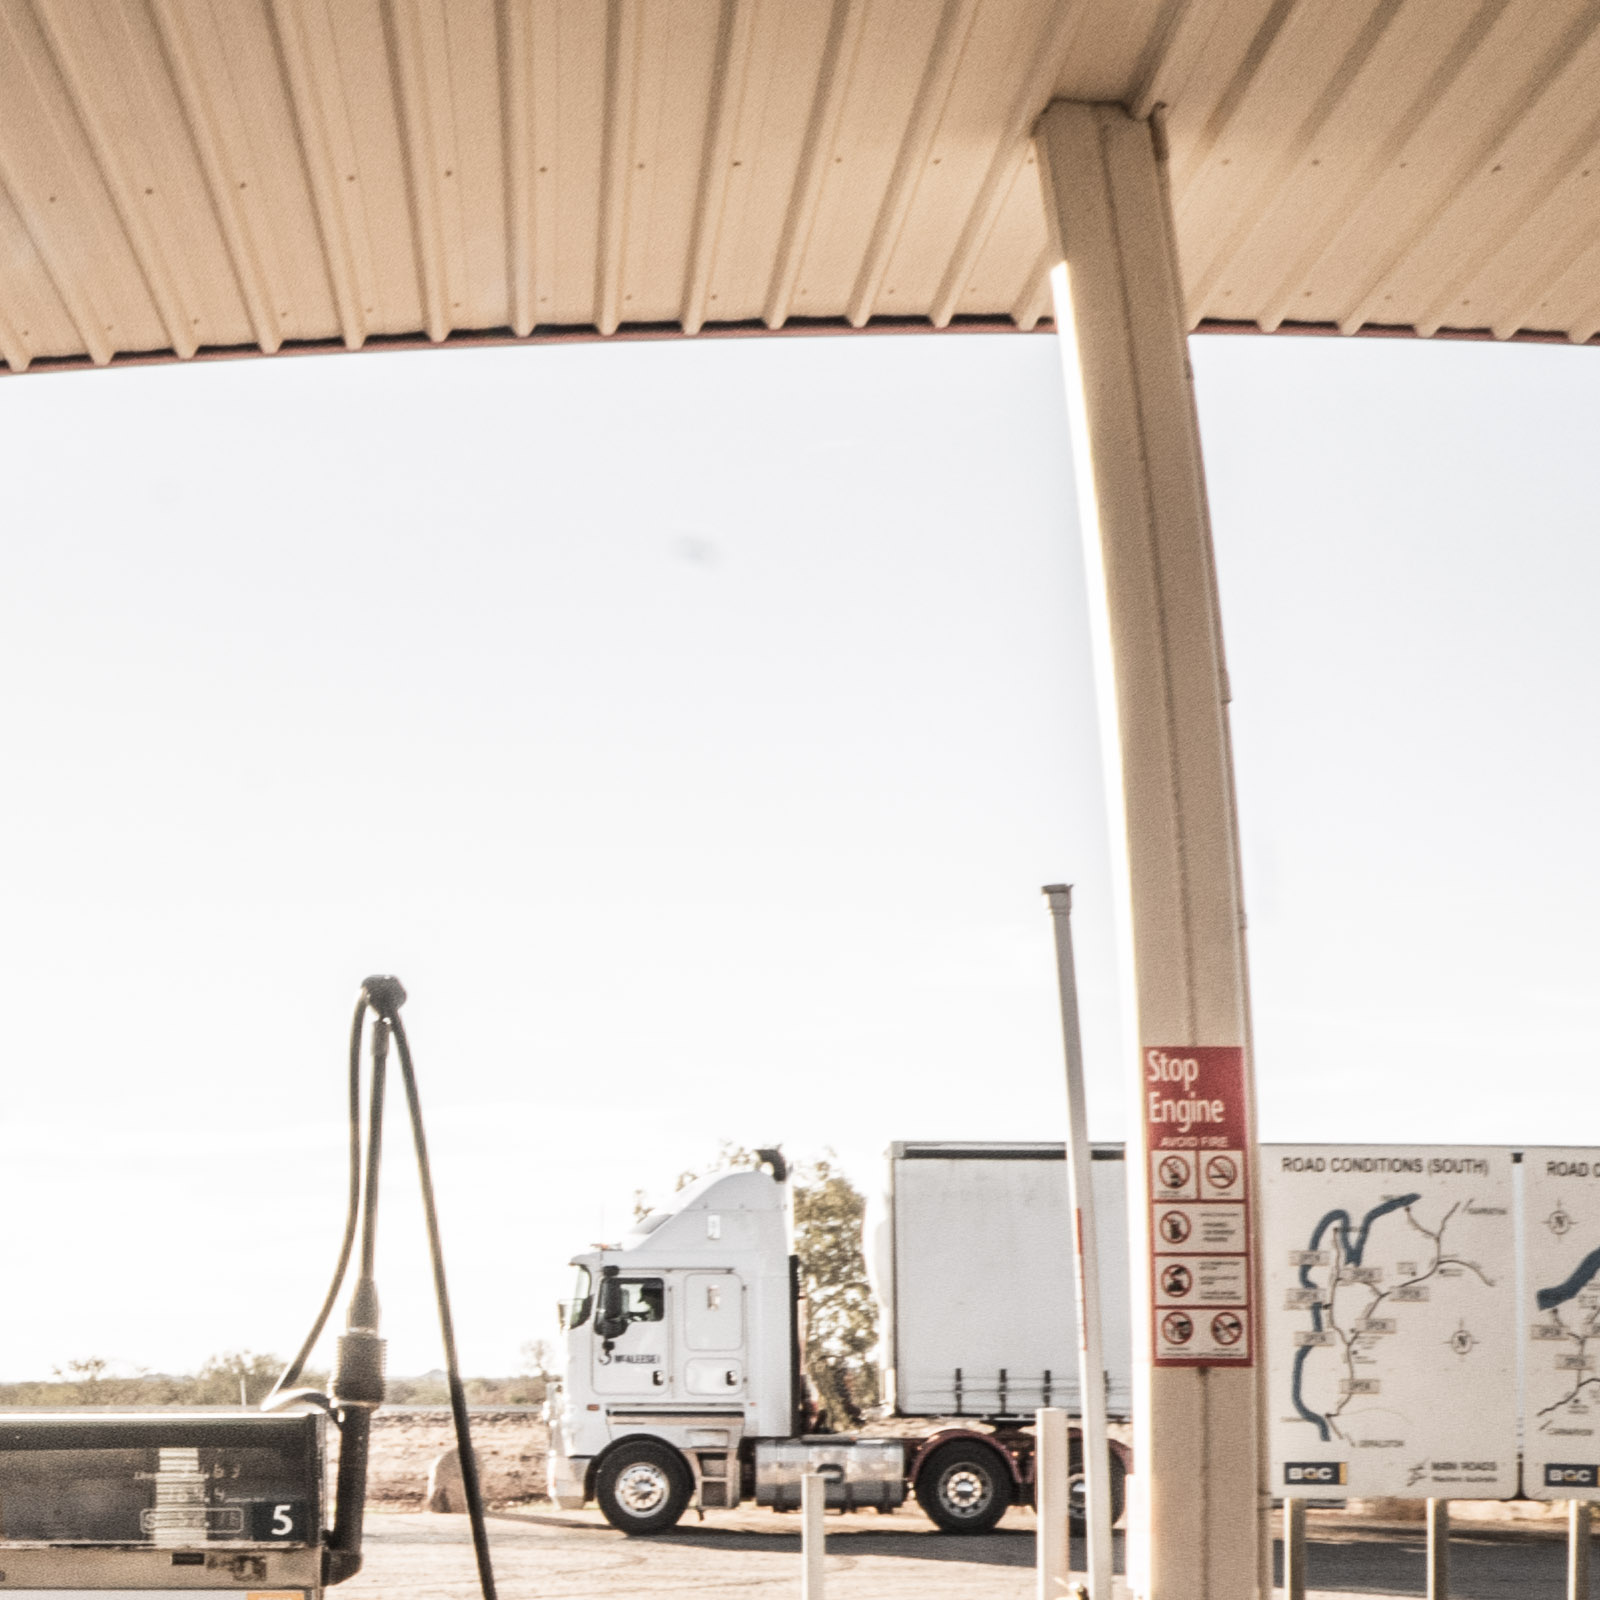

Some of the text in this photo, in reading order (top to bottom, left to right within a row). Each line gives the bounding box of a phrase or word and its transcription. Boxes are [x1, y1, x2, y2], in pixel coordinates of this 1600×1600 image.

[1148, 1050, 1198, 1091] Stop
[1148, 1091, 1225, 1133] Engine
[1282, 1157, 1488, 1176] ROAD CONDITIONS (SOUTH)
[1546, 1161, 1589, 1177] ROAD
[271, 1504, 293, 1536] 5
